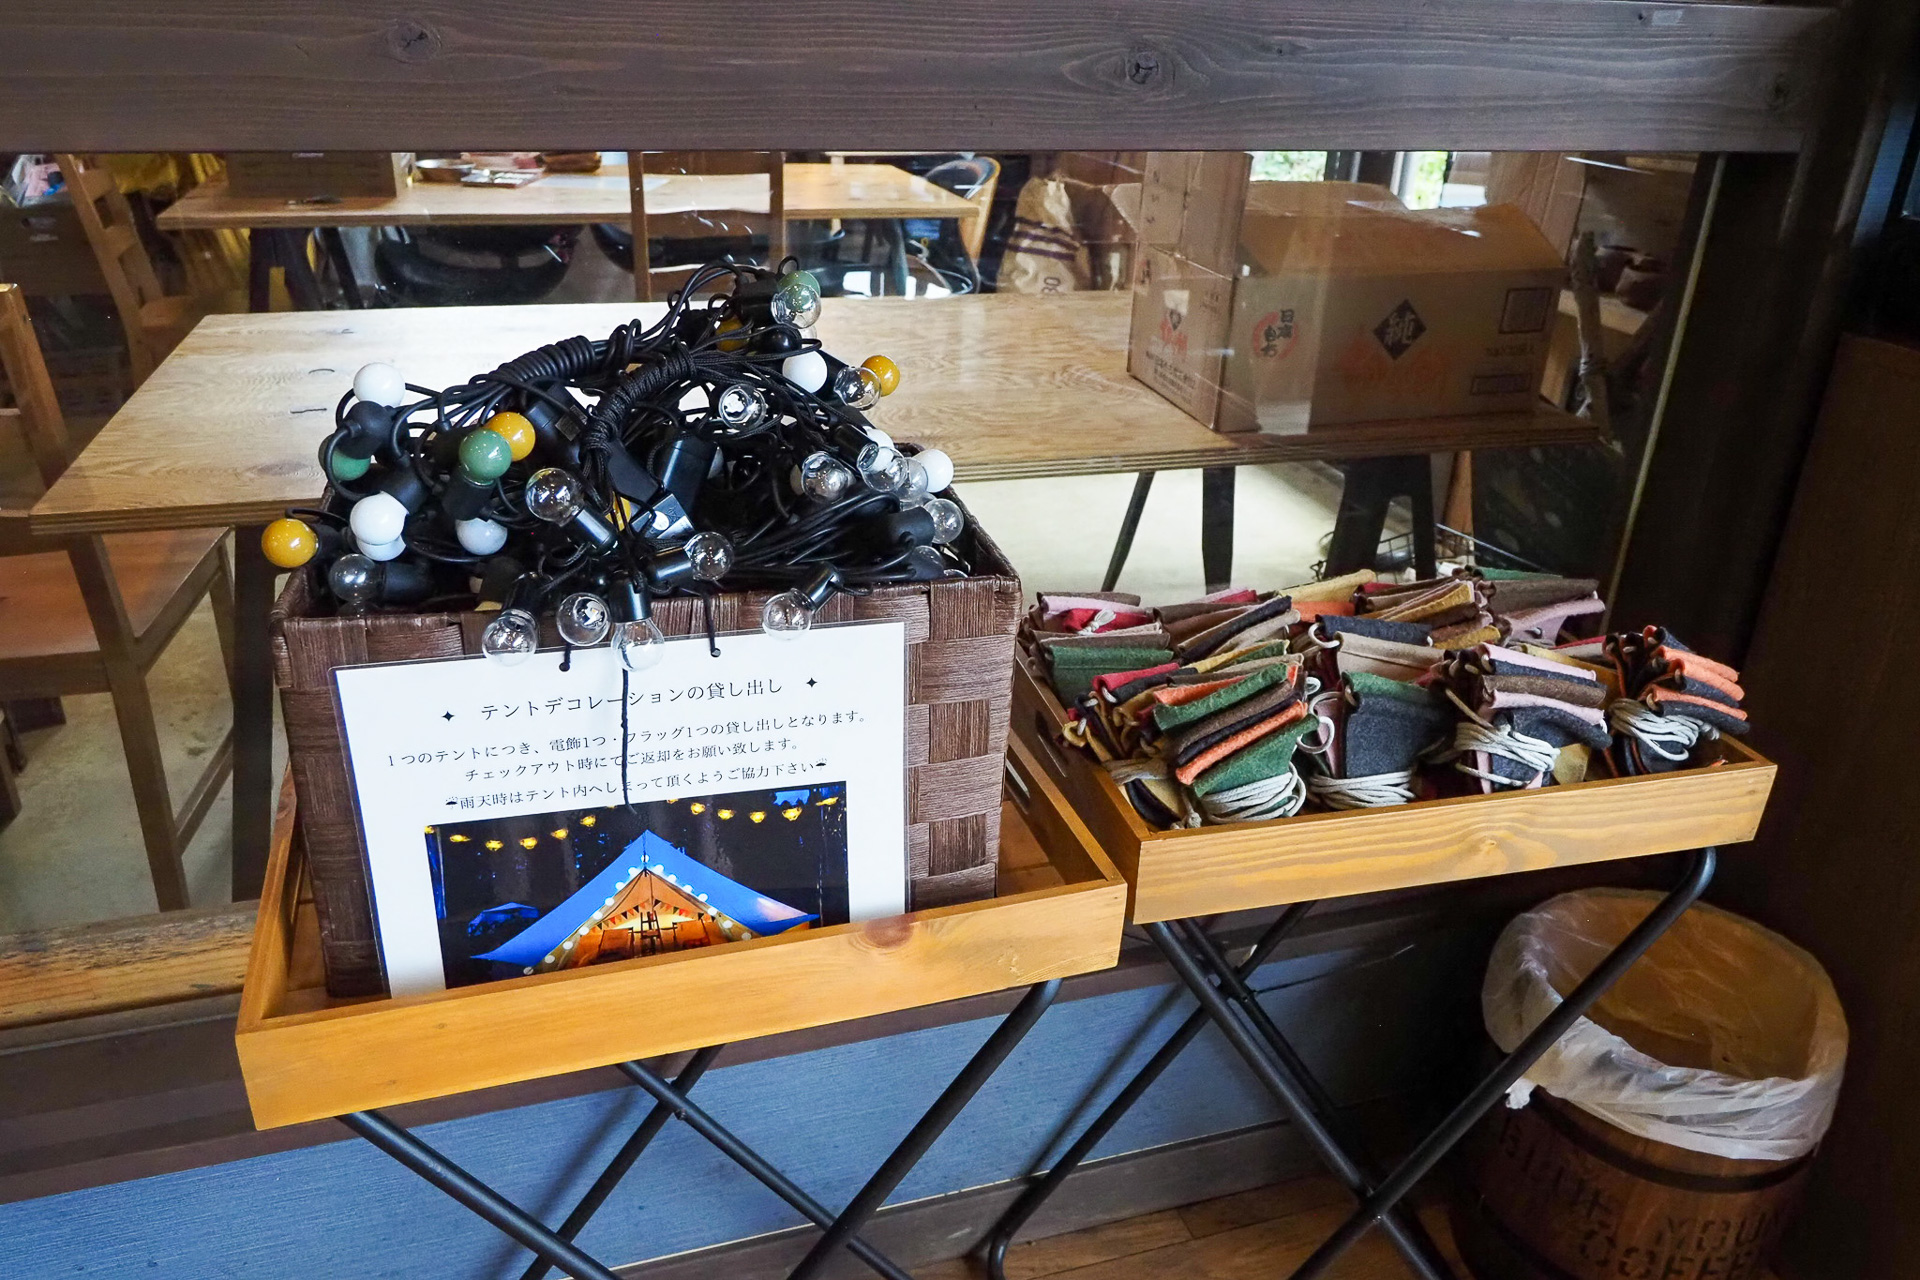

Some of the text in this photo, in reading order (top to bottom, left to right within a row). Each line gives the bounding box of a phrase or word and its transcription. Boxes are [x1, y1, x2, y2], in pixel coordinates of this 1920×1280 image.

[481, 678, 783, 720] テントデコレーションの貸し出し
